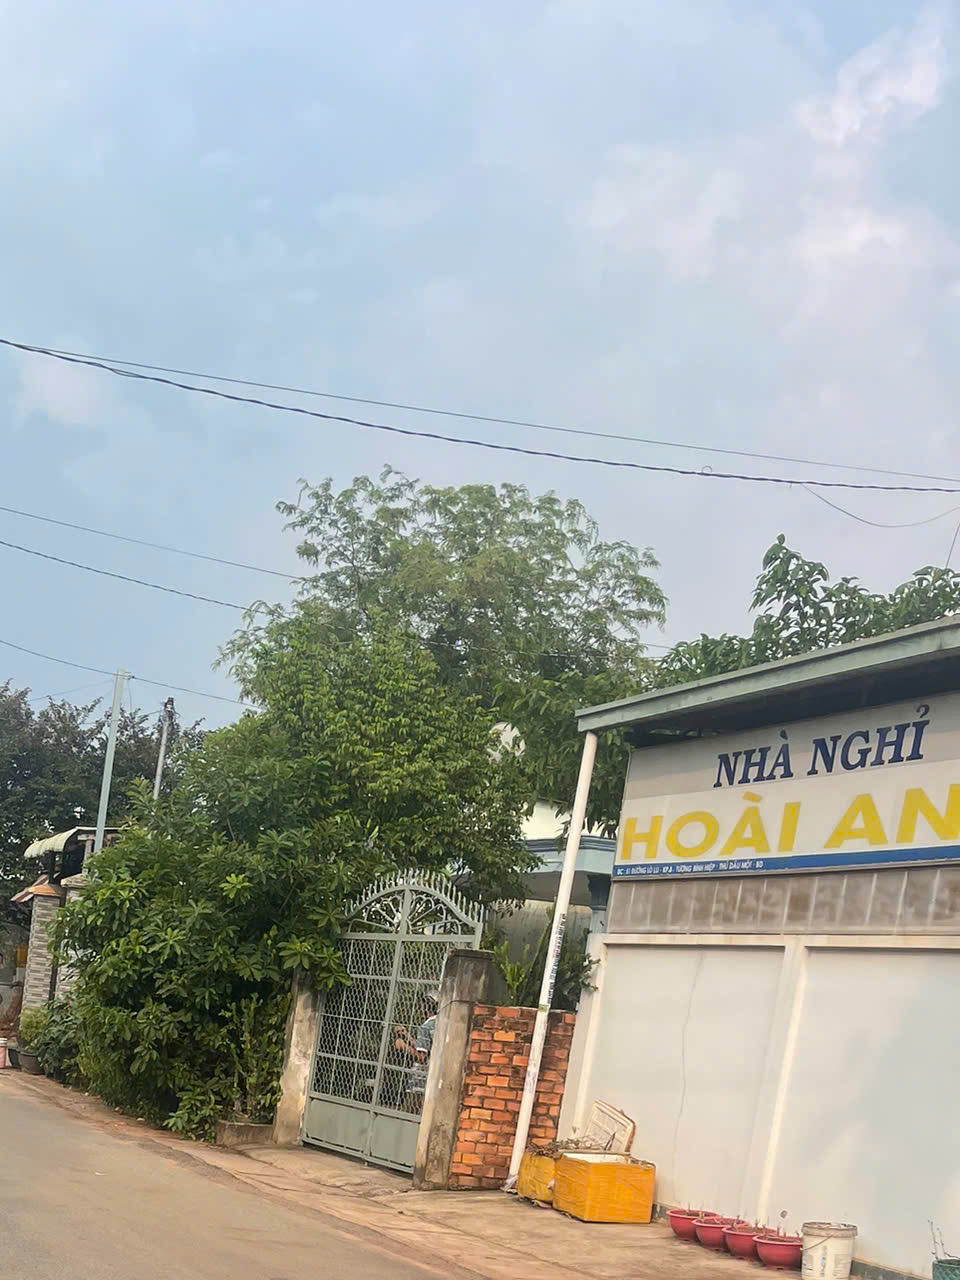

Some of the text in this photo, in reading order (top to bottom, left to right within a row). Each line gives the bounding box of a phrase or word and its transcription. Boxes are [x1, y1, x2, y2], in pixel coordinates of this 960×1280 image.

[713, 703, 931, 788] NHÀ NGHỈ
[620, 790, 802, 860] HOÀI
